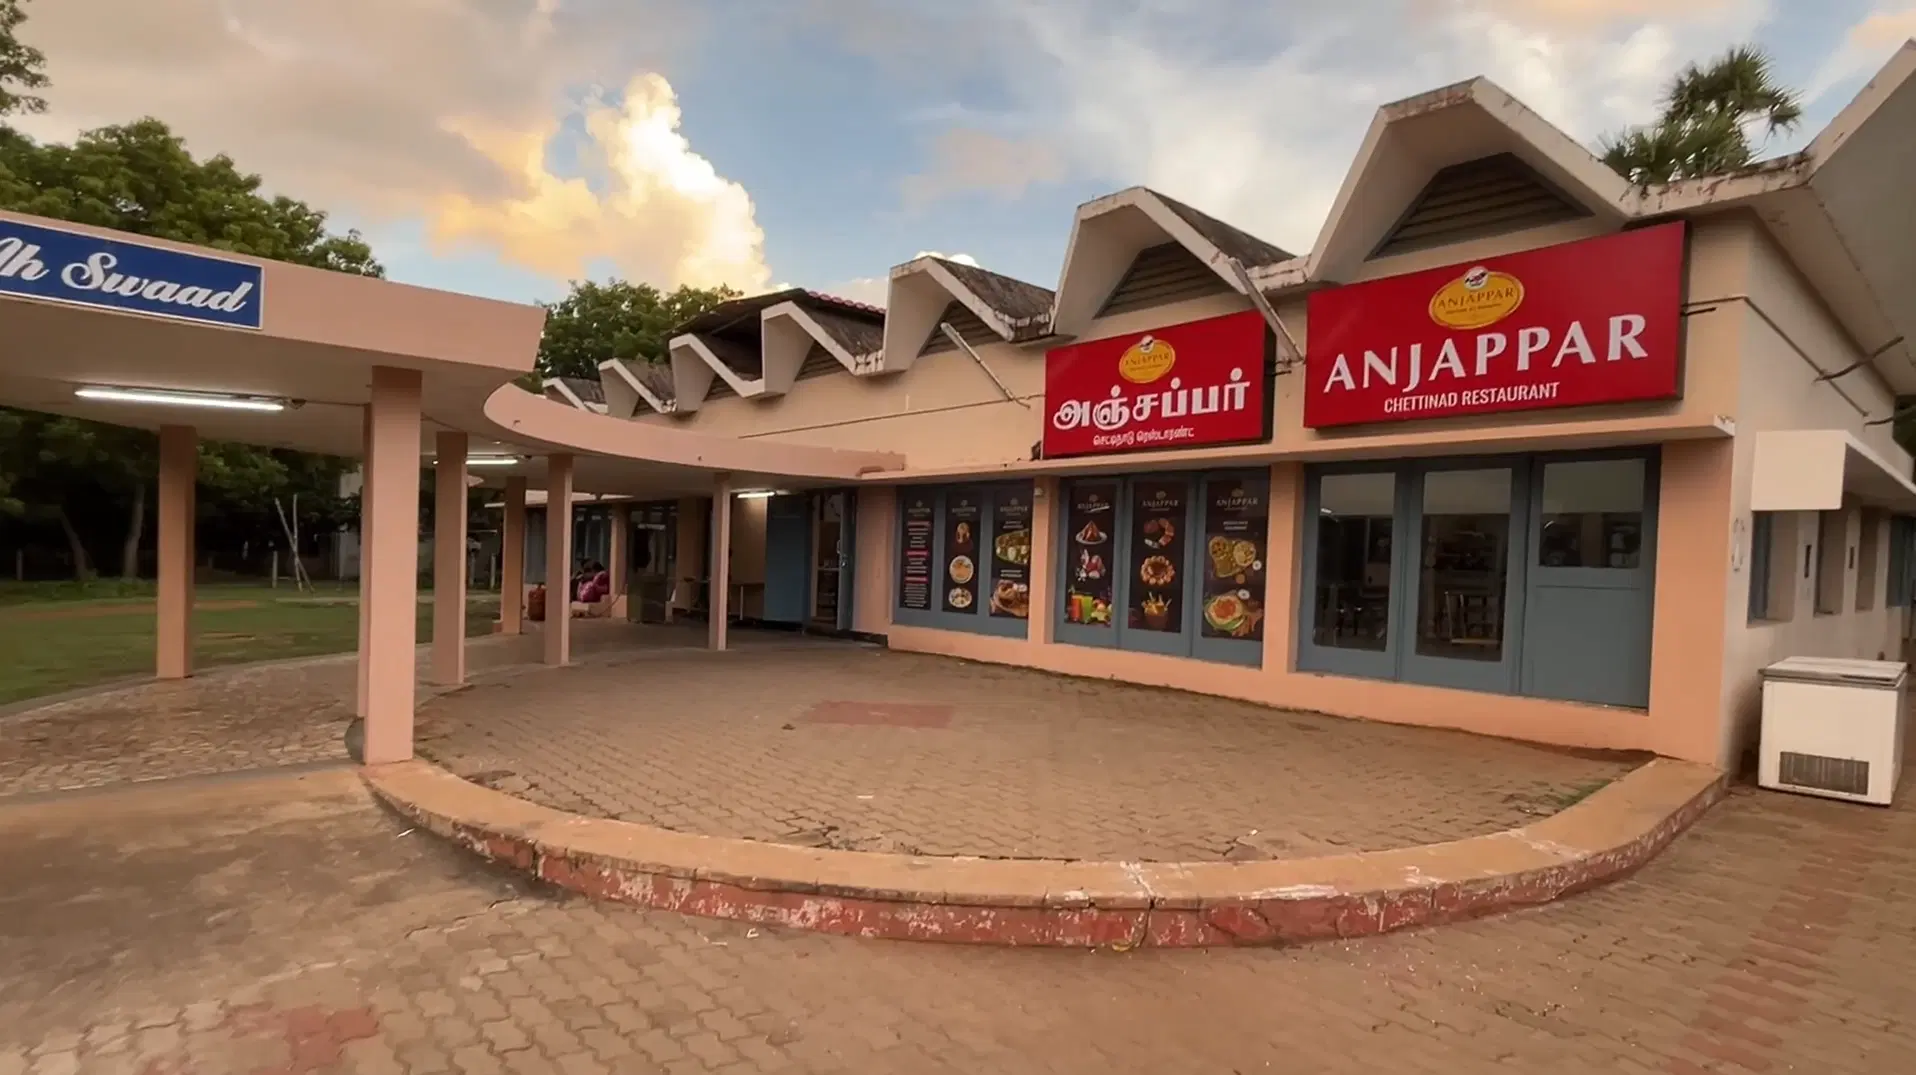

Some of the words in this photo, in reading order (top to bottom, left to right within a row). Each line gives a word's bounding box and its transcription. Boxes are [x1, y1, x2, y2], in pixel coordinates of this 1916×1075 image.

[61, 252, 254, 312] Swaad
[1437, 287, 1514, 309] ANJAPPAR
[1324, 314, 1648, 392] ANJAPPAR
[1053, 367, 1250, 431] அஞ்சப்பர்
[1384, 392, 1458, 413] CHETTINAD
[1462, 382, 1560, 406] RESTAURANT
